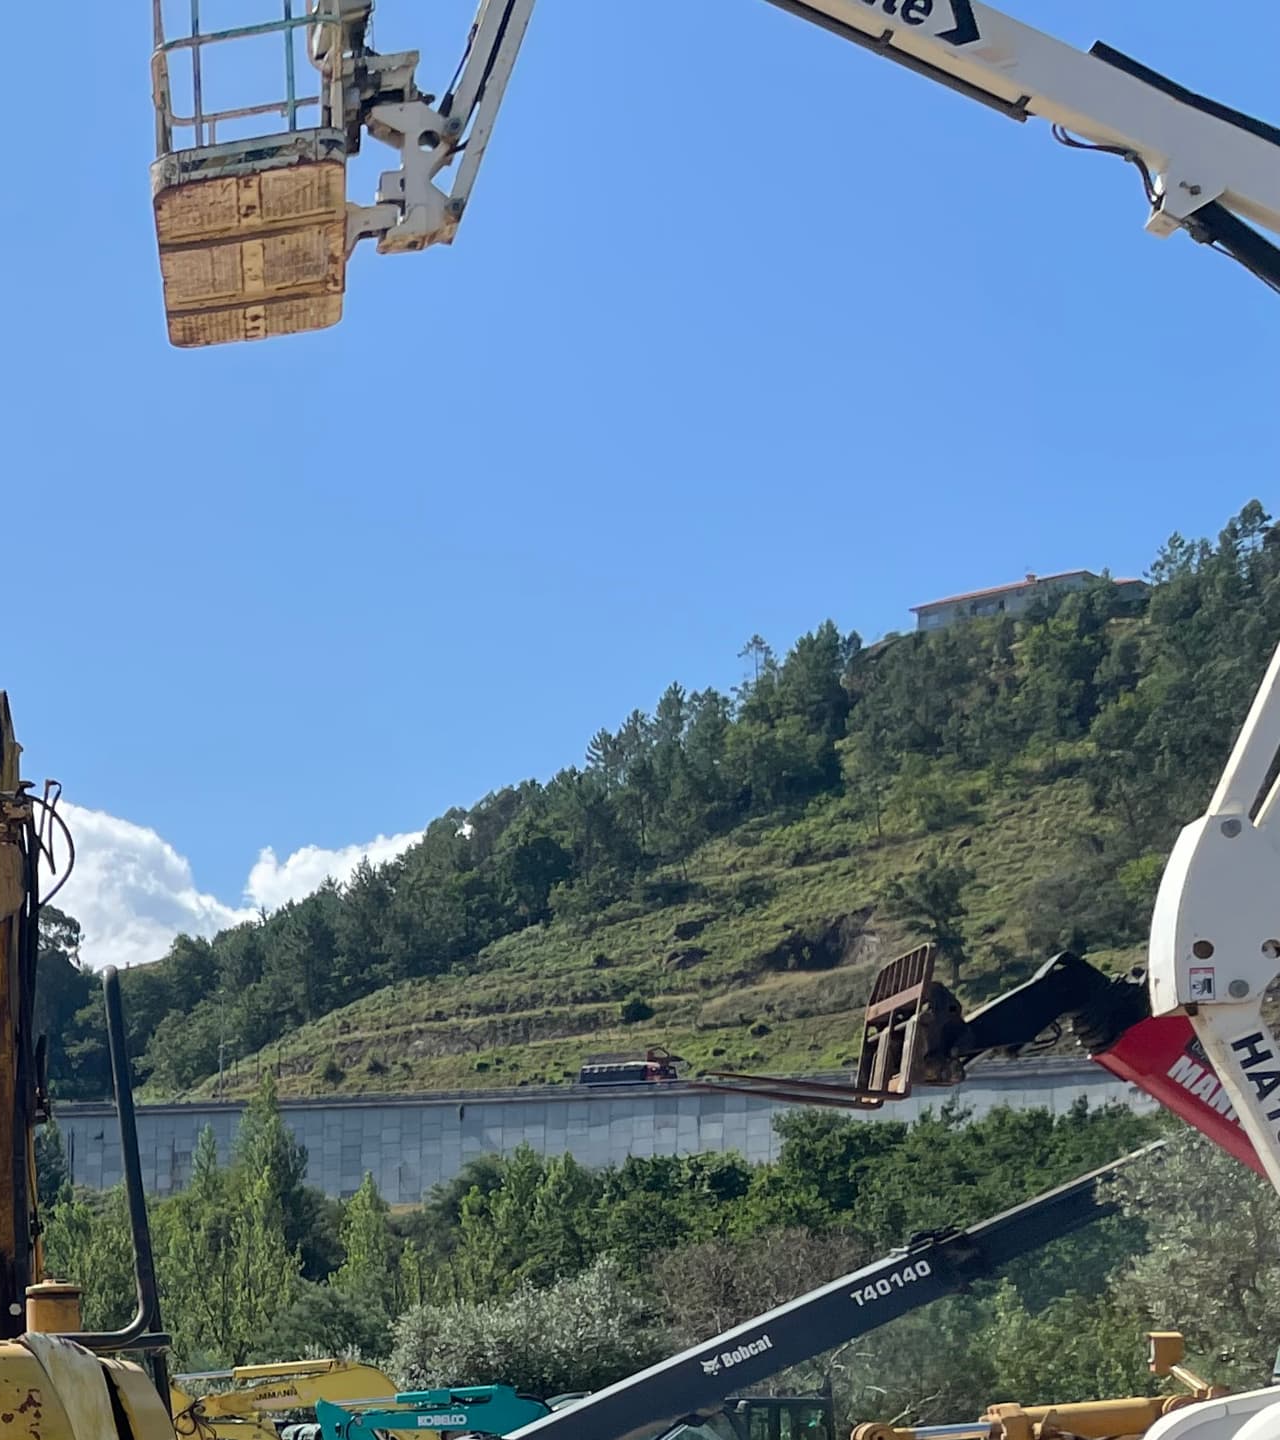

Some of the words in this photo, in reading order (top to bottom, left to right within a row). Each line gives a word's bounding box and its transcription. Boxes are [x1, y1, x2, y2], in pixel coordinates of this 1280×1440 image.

[850, 1260, 931, 1306] T40140
[721, 1334, 773, 1368] Bobcat
[417, 1414, 468, 1427] KOBELCO
